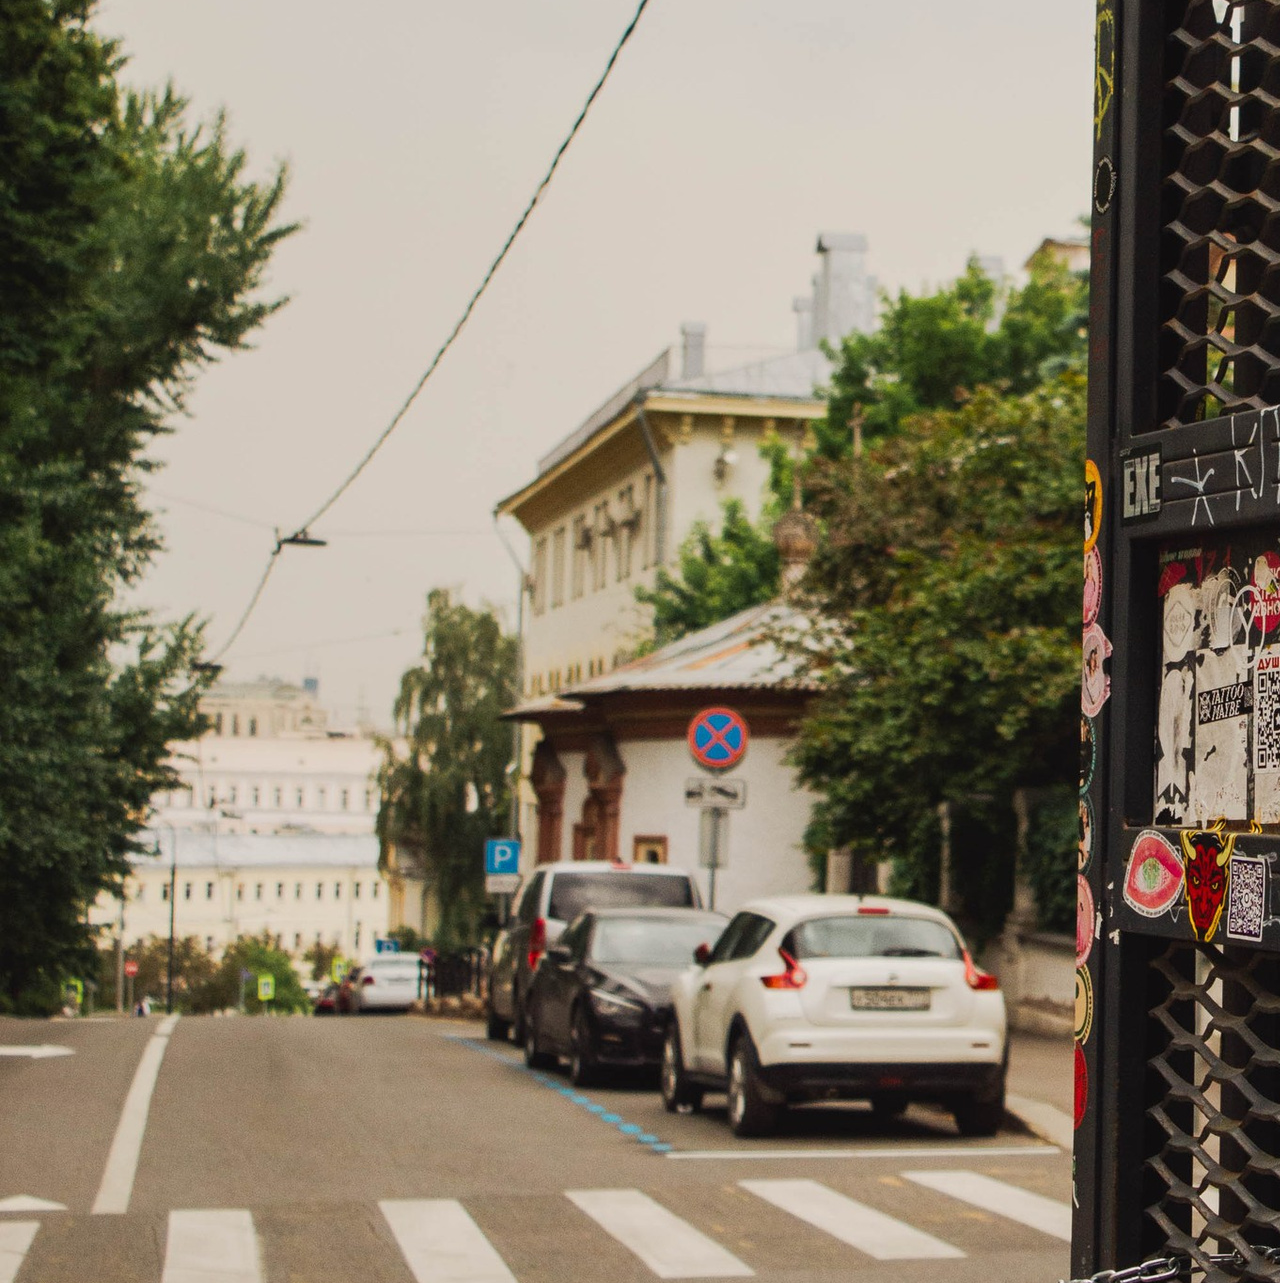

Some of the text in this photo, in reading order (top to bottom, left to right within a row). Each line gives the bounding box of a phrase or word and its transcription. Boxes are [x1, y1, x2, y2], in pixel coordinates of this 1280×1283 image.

[1123, 452, 1160, 519] EXE
[1211, 683, 1245, 706] TATTOO
[1211, 699, 1241, 721] MAYBE
[494, 845, 511, 868] P
